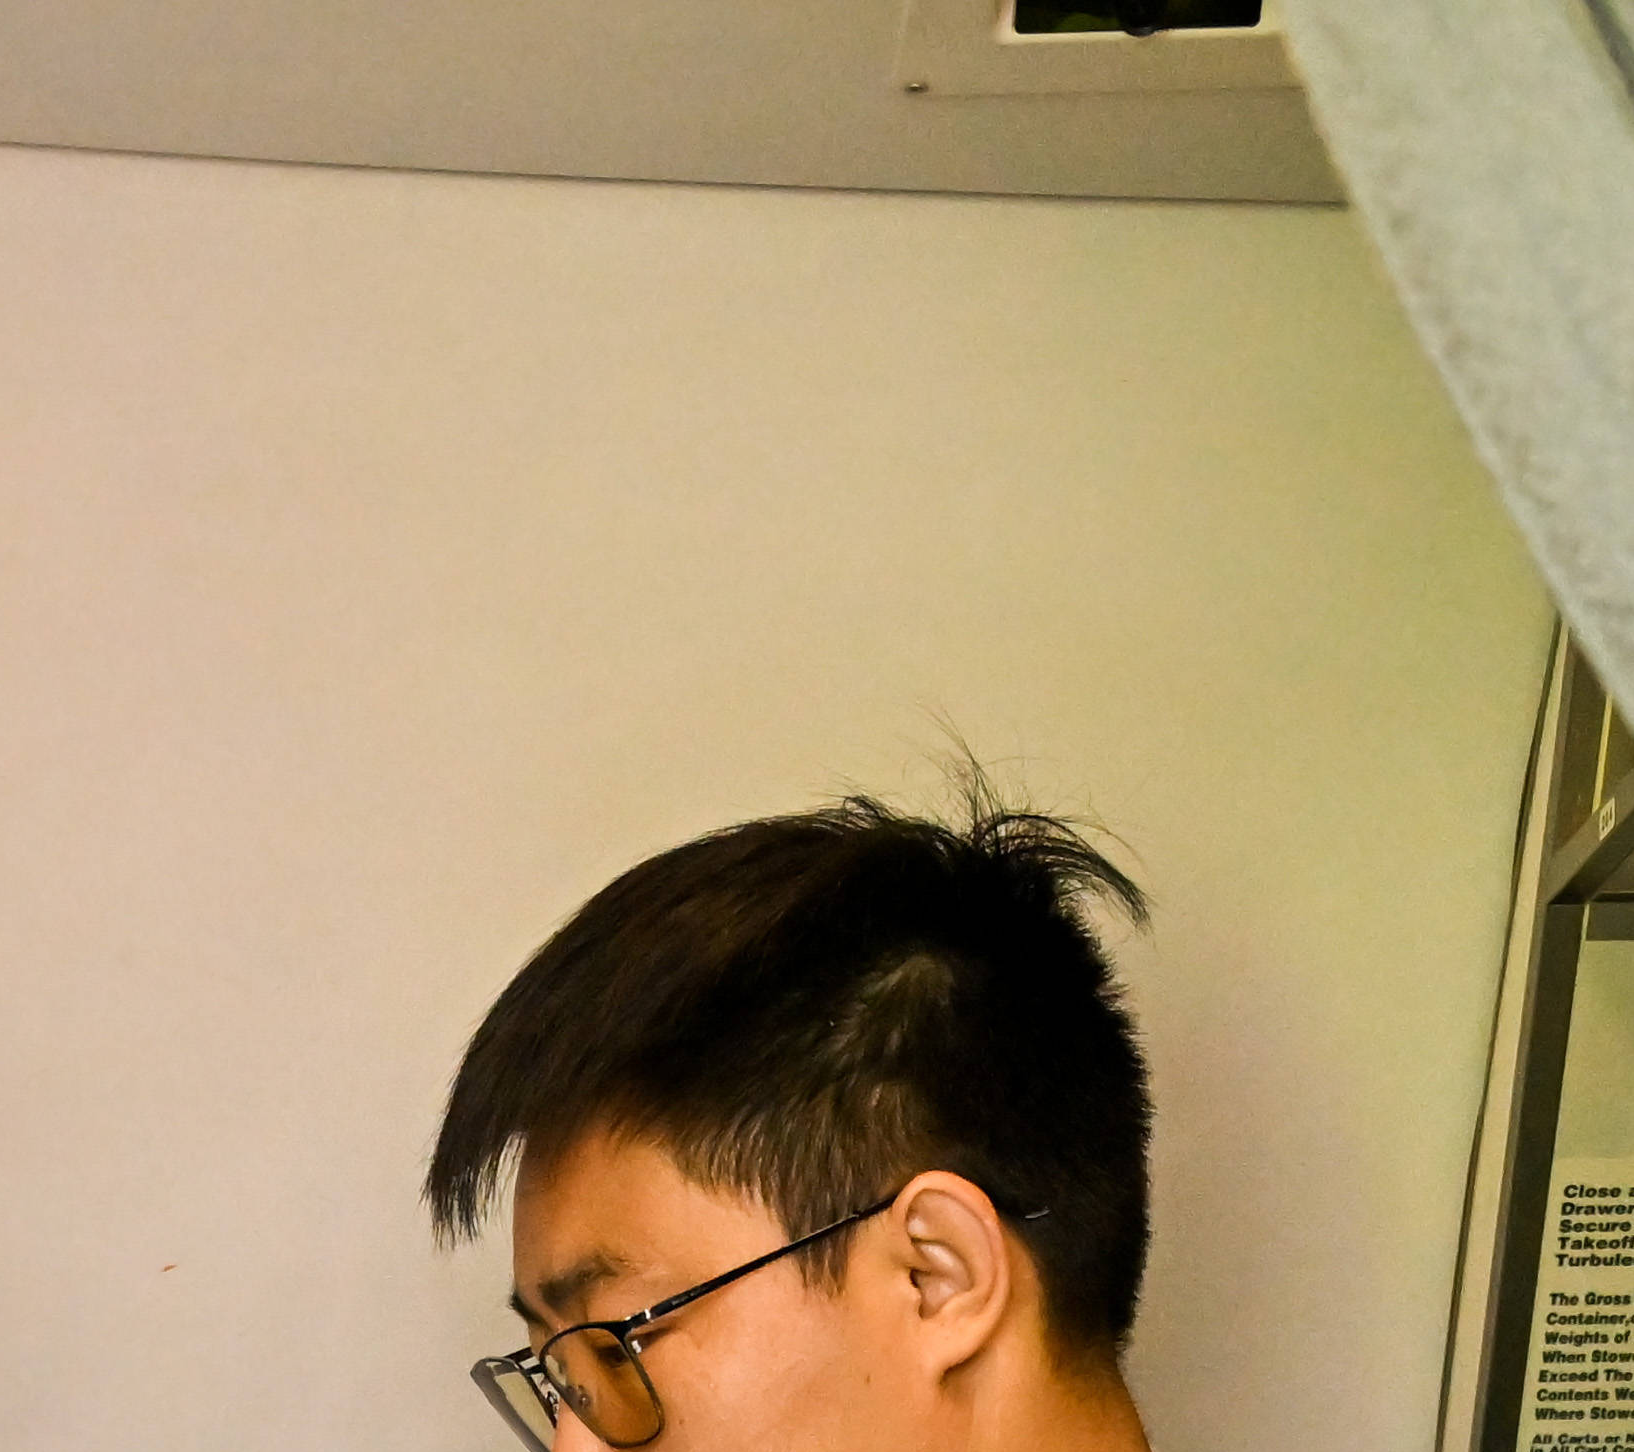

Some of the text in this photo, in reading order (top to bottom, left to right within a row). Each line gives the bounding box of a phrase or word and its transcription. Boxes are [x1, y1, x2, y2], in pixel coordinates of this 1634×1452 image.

[1564, 1185, 1621, 1197] Close
[1559, 1220, 1630, 1233] Secure
[1550, 1293, 1578, 1305] The
[1585, 1292, 1631, 1305] Gross
[1545, 1331, 1609, 1346] Weights
[1614, 1330, 1630, 1343] of
[1543, 1351, 1585, 1363] When
[1539, 1370, 1598, 1382] Exceed
[1605, 1369, 1632, 1382] The
[1537, 1388, 1609, 1401] Contents
[1535, 1408, 1584, 1420] Where
[1533, 1434, 1552, 1444] All
[1558, 1433, 1599, 1444] Carts
[1605, 1434, 1620, 1444] or
